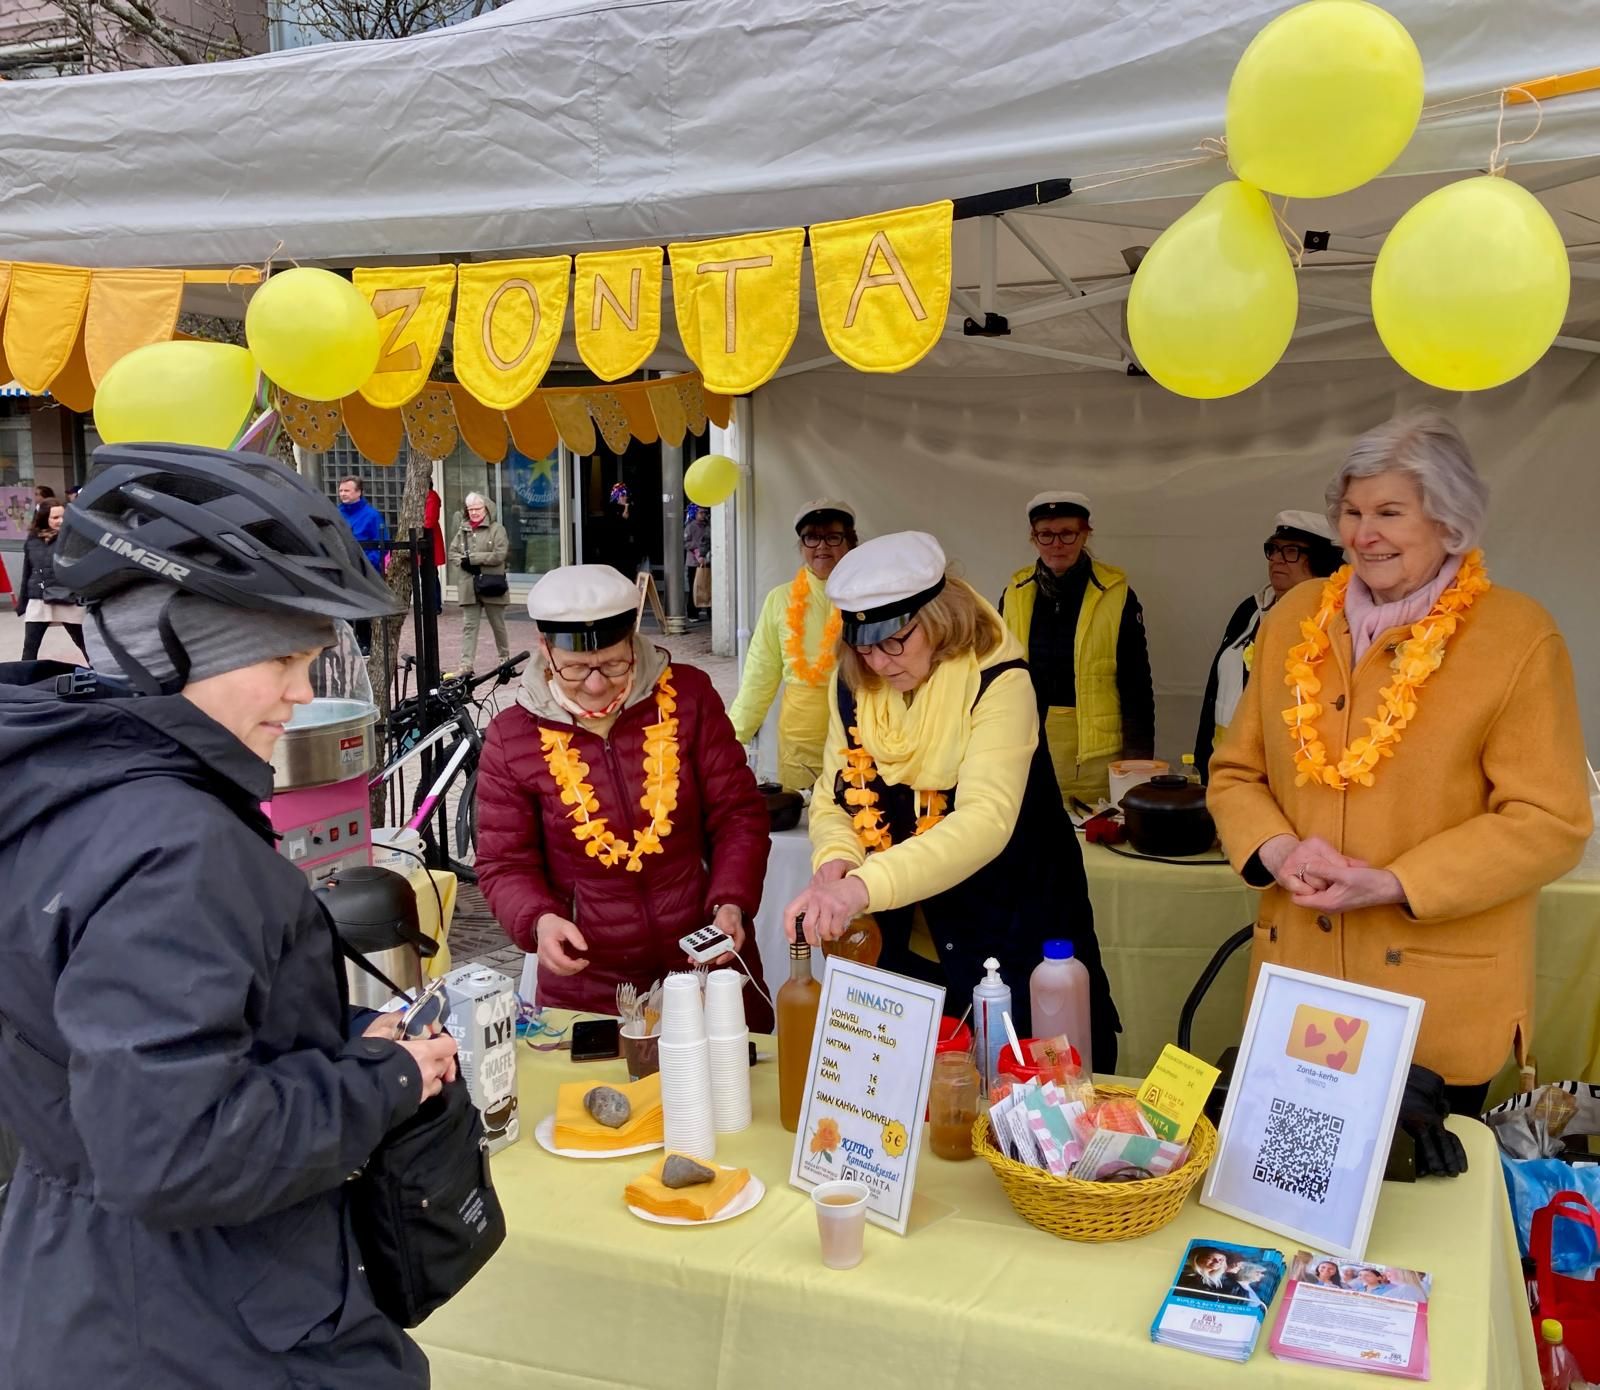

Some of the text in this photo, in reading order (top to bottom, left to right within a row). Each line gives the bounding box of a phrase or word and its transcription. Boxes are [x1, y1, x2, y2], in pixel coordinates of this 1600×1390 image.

[371, 231, 927, 374] ZONTA
[847, 987, 904, 1017] HINNASTO
[484, 1016, 512, 1050] LY!
[829, 1018, 872, 1039] (KERMAVAAHTO
[878, 1034, 897, 1048] HILLO)
[831, 1008, 886, 1033] VOHVELI 4€
[826, 1036, 880, 1062] HATTARA 2€
[820, 1068, 876, 1096] KAHVI 2€
[822, 1057, 878, 1084] SIMA 1€
[1296, 1064, 1339, 1083] Zonta-kerho
[861, 1108, 891, 1127] VOHVELI
[1147, 1113, 1169, 1134] ONTA
[841, 1138, 874, 1159] KIITOS
[846, 1152, 900, 1183] kannatuksesta!
[860, 1172, 891, 1193] ZONTA
